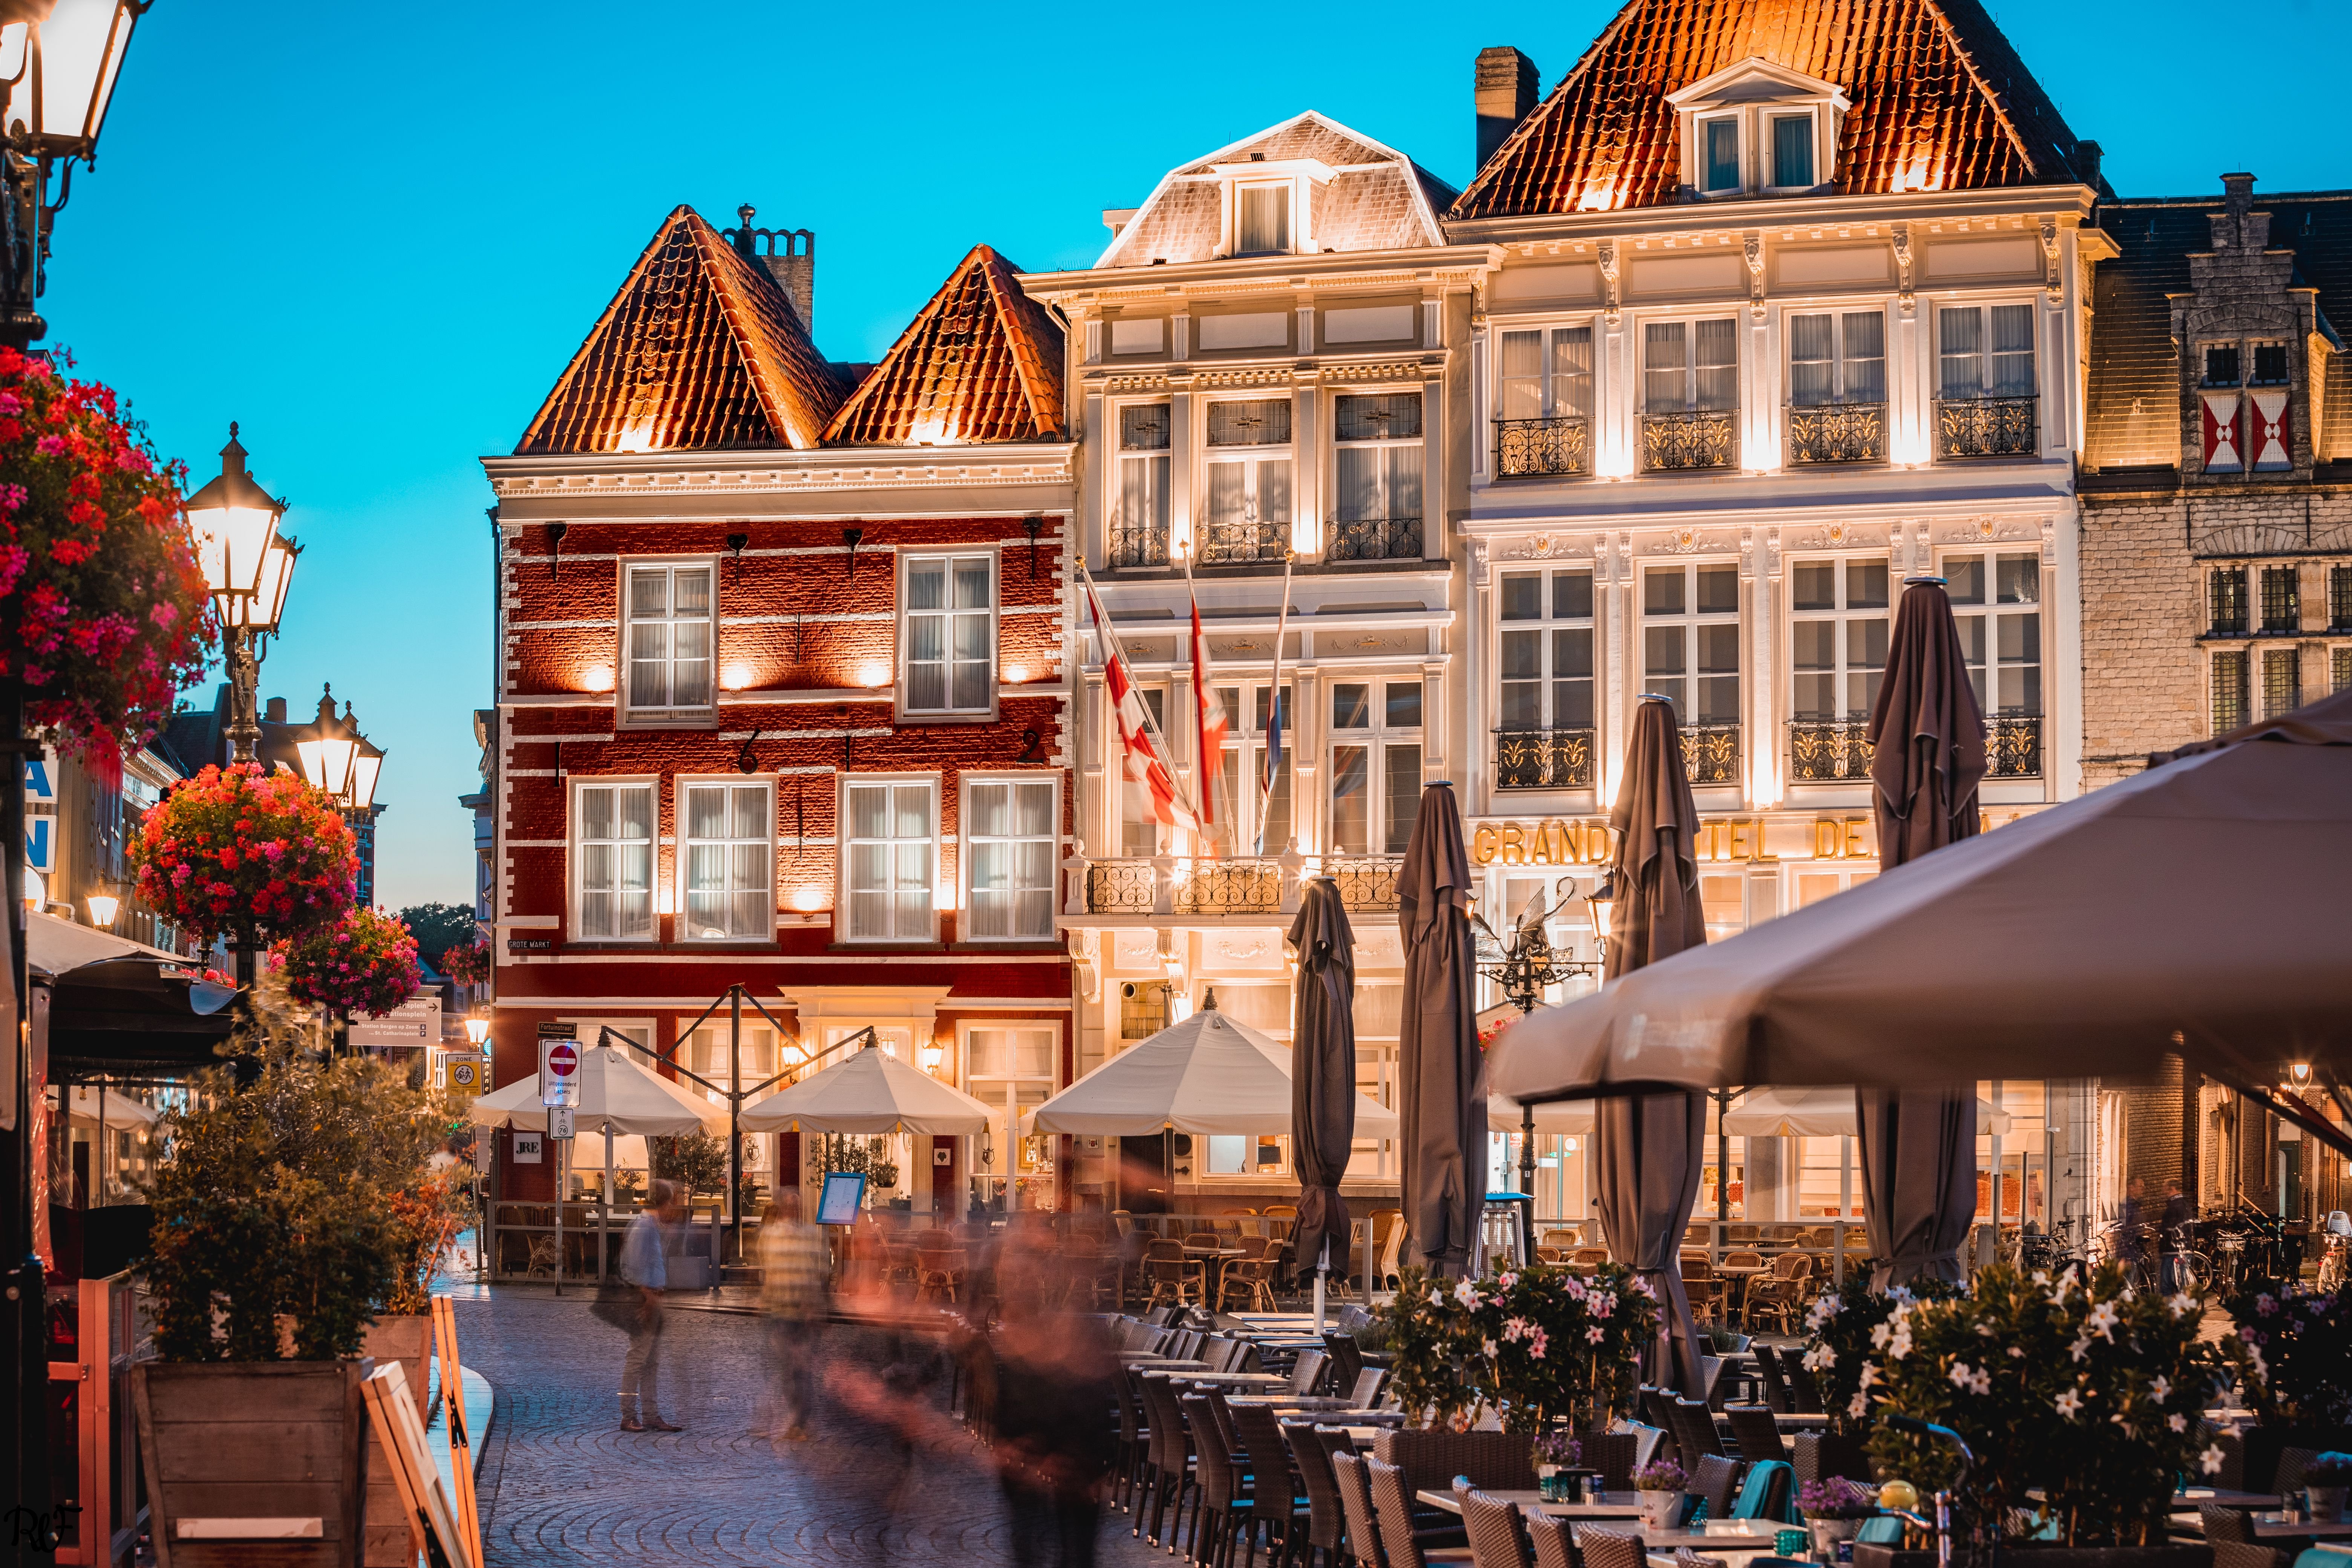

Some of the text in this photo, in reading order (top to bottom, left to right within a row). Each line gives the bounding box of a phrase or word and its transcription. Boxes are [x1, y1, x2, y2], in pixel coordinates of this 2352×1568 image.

[738, 728, 761, 775] 6
[1016, 729, 1044, 764] 2
[1474, 817, 1870, 867] GRAND TEL DE
[516, 1142, 539, 1154] JRE
